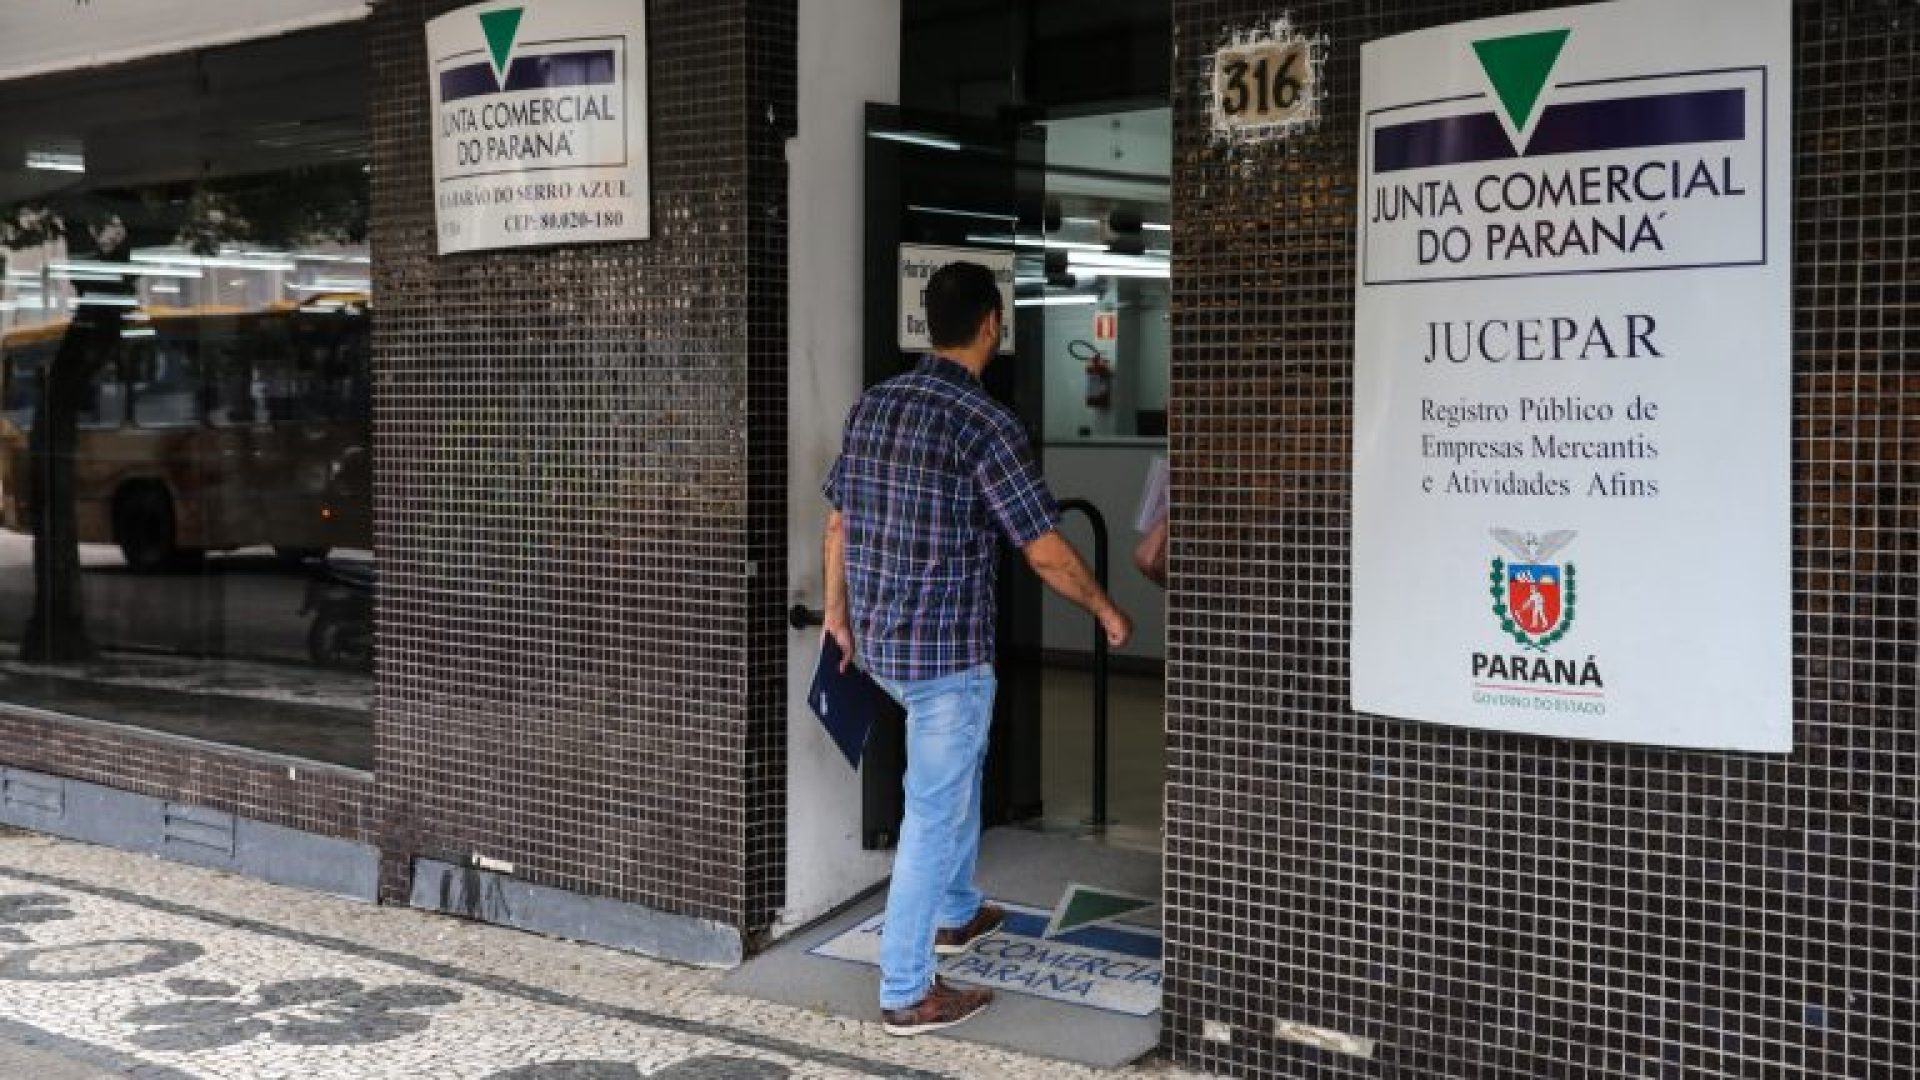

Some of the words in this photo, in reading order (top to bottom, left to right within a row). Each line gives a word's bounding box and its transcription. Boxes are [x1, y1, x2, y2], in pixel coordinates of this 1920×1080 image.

[1222, 54, 1302, 114] 316
[481, 94, 616, 131] COMERCIAL
[457, 139, 482, 166] DO
[577, 179, 632, 199] AZUL
[1372, 181, 1463, 223] JUNTA
[1474, 157, 1746, 213] COMERCIAL
[1417, 226, 1471, 266] DO
[1486, 210, 1669, 261] PARANÁ
[1424, 314, 1665, 363] JUCEPAR
[1420, 397, 1508, 428] Registro
[1519, 396, 1614, 422] Público
[1626, 394, 1659, 422] de
[1421, 433, 1524, 464] Empresas
[1531, 432, 1659, 459] Mercantis
[1421, 474, 1434, 494] e
[1445, 469, 1571, 496] Atividades
[1586, 471, 1659, 497] Afins
[1472, 651, 1604, 688] PARANÁ
[974, 938, 1162, 987] COMERCIA
